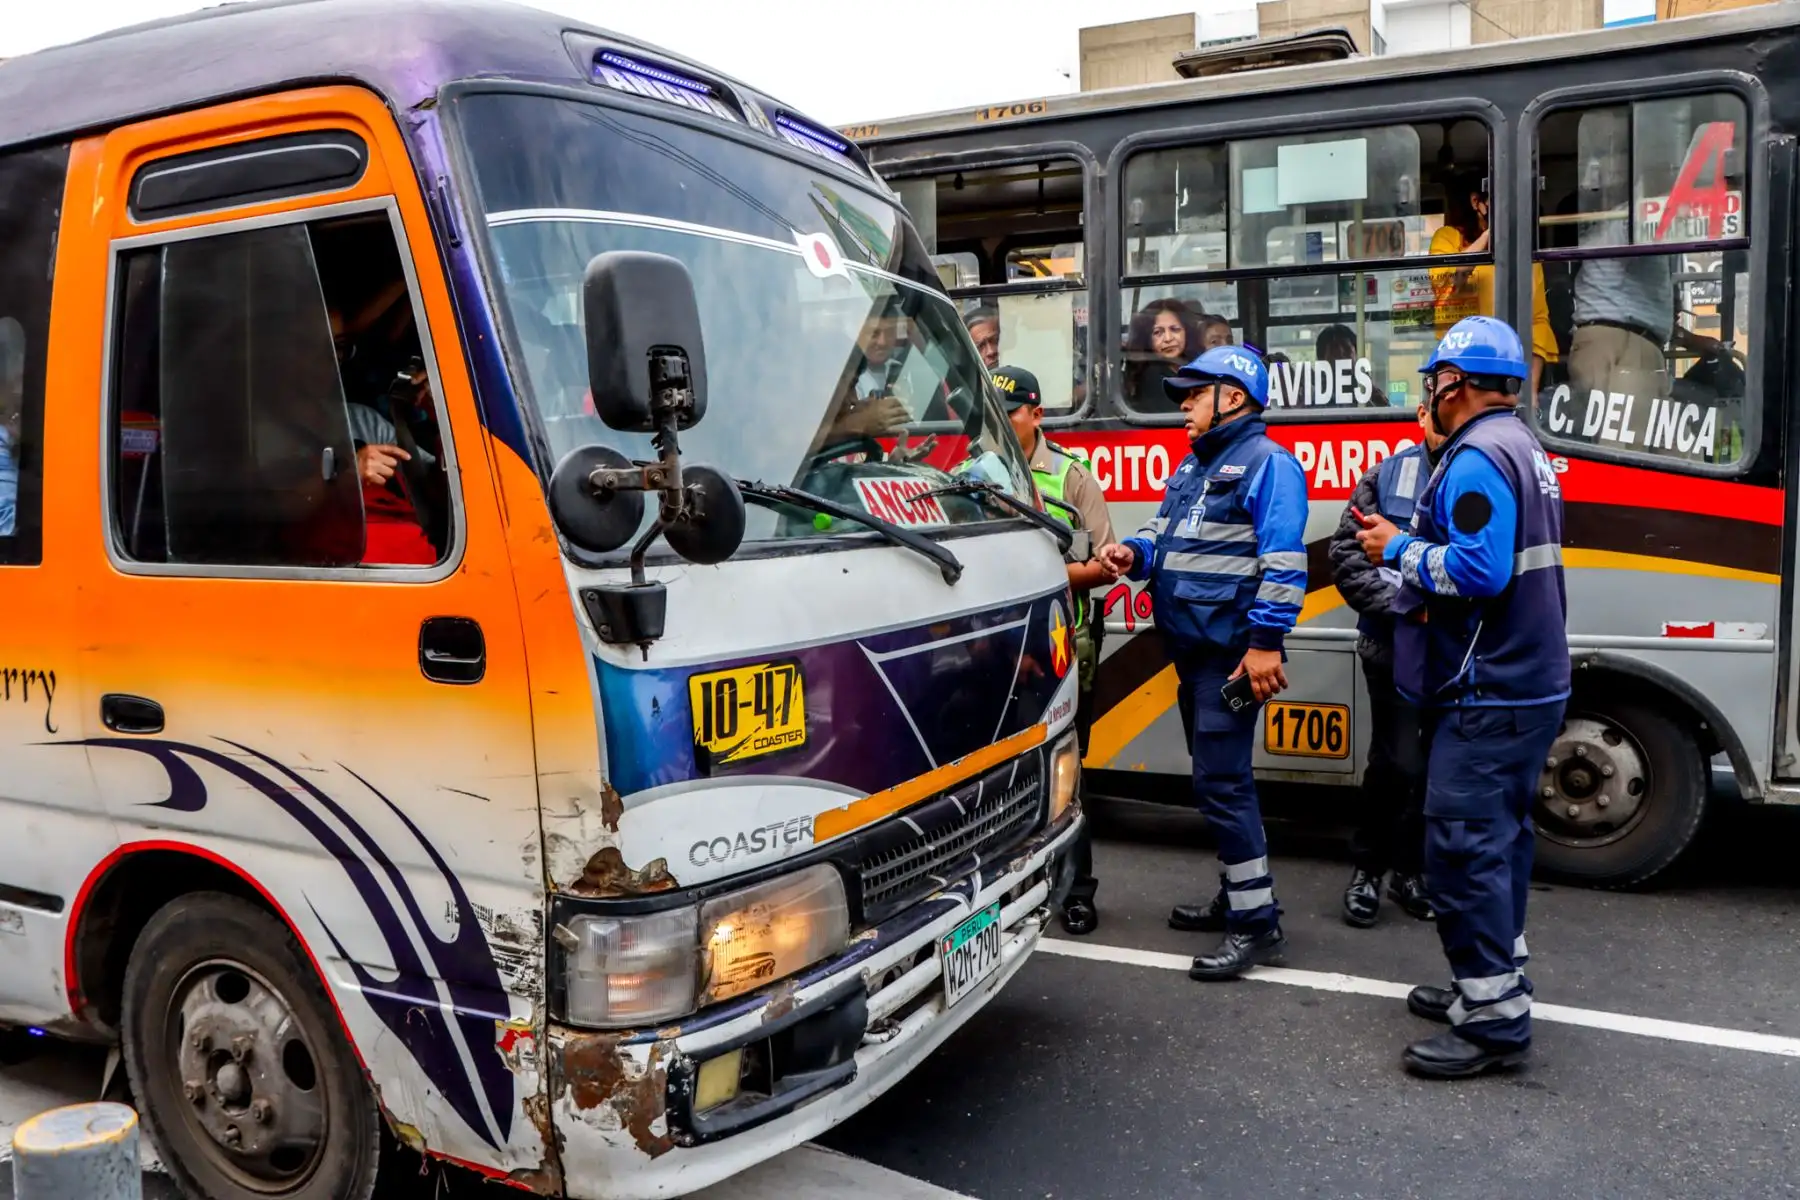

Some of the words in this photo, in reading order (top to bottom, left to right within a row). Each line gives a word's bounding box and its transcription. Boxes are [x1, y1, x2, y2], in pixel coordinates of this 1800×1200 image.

[977, 101, 1043, 120] 1706
[1223, 354, 1259, 377] ATU
[1436, 331, 1474, 352] ATU
[1266, 358, 1373, 407] AVIDES
[1549, 384, 1575, 434] C.
[1582, 389, 1636, 444] DEL
[1643, 398, 1718, 457] INCA
[1296, 438, 1416, 489] PARD
[859, 480, 946, 525] ANCON
[0, 667, 60, 734] rry
[700, 667, 793, 744] 10-47
[753, 729, 804, 751] COASTER
[1272, 706, 1343, 753] 1706
[688, 814, 815, 868] COASTER
